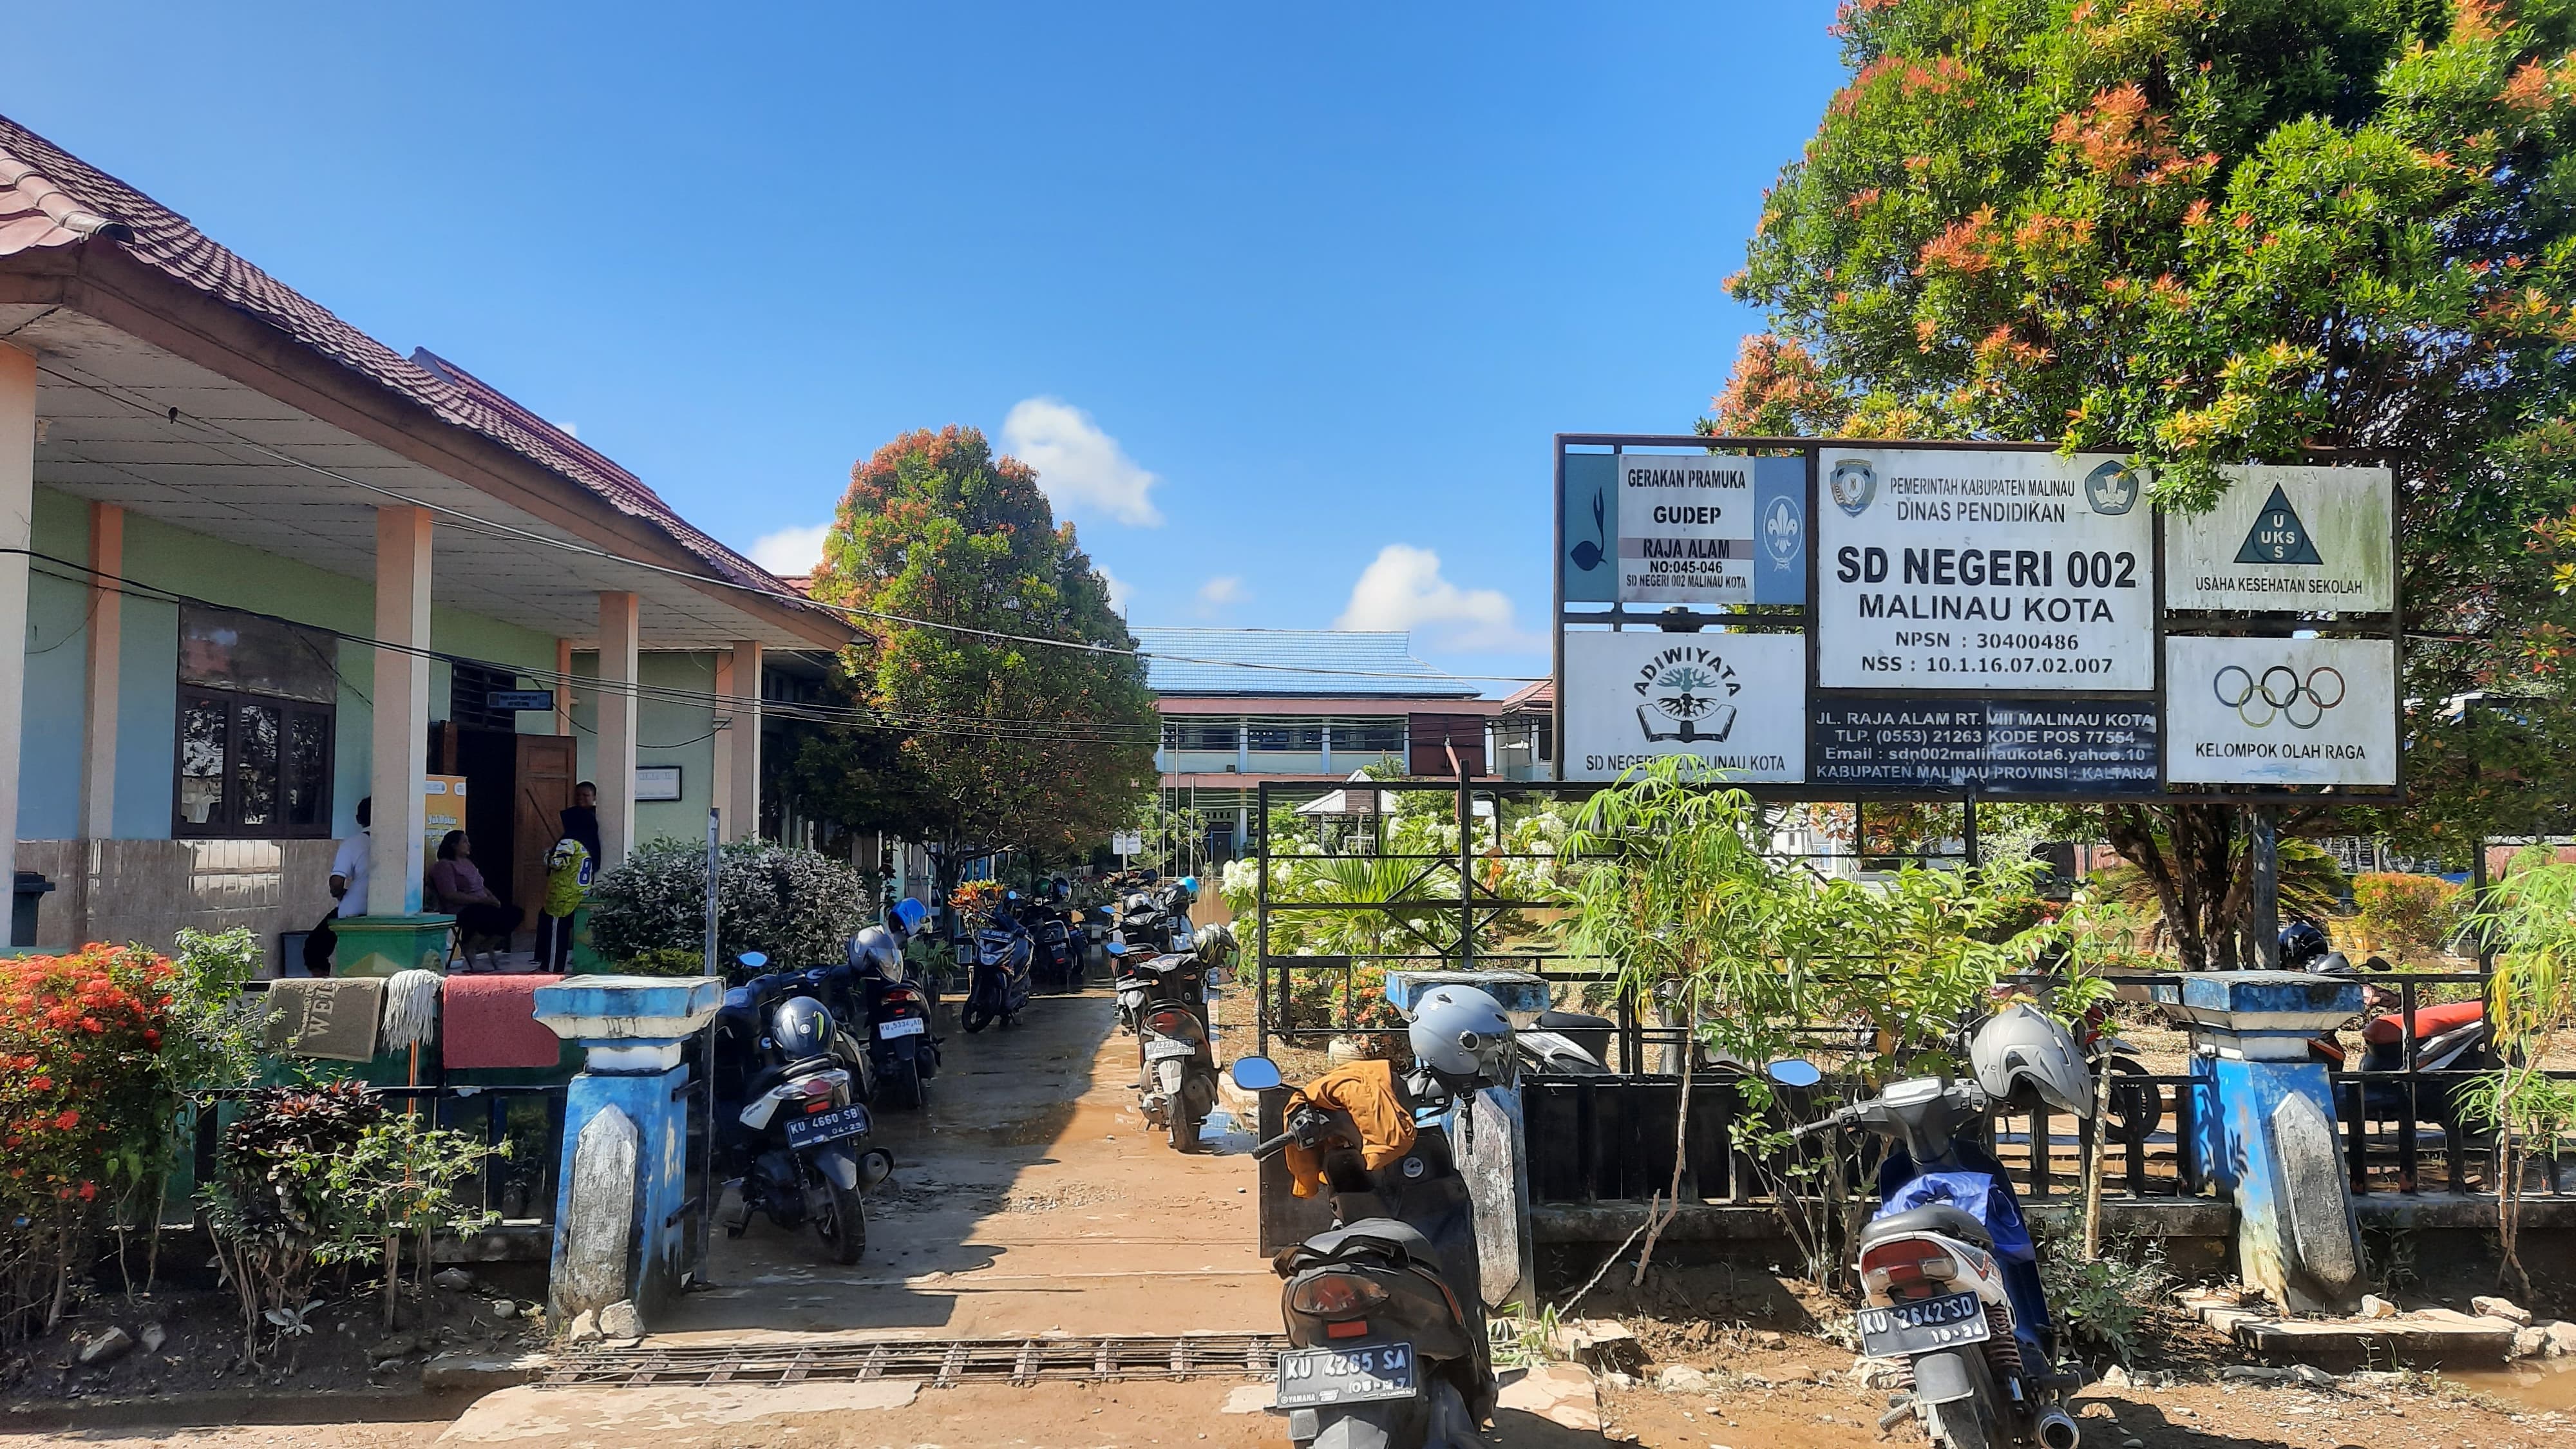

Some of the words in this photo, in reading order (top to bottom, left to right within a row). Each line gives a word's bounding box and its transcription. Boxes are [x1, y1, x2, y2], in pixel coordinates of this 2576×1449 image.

[1628, 469, 1685, 488] GERAKAN
[1689, 469, 1746, 489] PRAMUKA
[1891, 477, 1958, 496] PEMERINTAH
[1961, 478, 2025, 497] KABUPATEN
[2029, 478, 2075, 497] MALINAU
[1653, 506, 1721, 524] GUDEP
[1897, 502, 1951, 522] DINAS
[1957, 502, 2065, 523] PENDIDIKAN
[2260, 531, 2295, 544] UKS
[1643, 538, 1682, 558] RAJA
[1688, 540, 1730, 558] ALAM
[1649, 560, 1723, 574] NO:045-046
[1837, 546, 1889, 583] SD
[1904, 548, 2052, 587] NEGERI
[2067, 551, 2137, 589] 002
[1626, 575, 1637, 587] SD
[1640, 575, 1669, 587] NEGERI
[1671, 575, 1685, 587] 002
[1687, 575, 1723, 588] MALINAU
[1726, 576, 1747, 589] KOTA
[2196, 577, 2235, 592] USAHA
[2239, 578, 2305, 592] KESEHATAN
[2309, 580, 2363, 594] SEKOLAH
[1859, 594, 2011, 621] MALINAU
[2025, 598, 2114, 623] KOTA
[1895, 631, 1950, 647] NPSN
[1976, 634, 2079, 650] 30400486
[1634, 647, 1742, 697] ADIWIYATA
[1862, 656, 1902, 672] NSS
[1927, 657, 2113, 674] 10.1.16.07.02.007
[1816, 712, 1841, 724] JL.
[1847, 712, 1895, 725] RAJA
[1899, 712, 1950, 725] ALAM
[1956, 712, 1982, 725] RT.
[2019, 713, 2099, 726] MALINAU
[2105, 714, 2155, 726] KOTA
[1835, 730, 1870, 743] TLP.
[1877, 730, 1927, 745] (0553)
[1933, 730, 1982, 743] 21263
[1988, 730, 2038, 743] KODE
[2043, 730, 2080, 743] POS
[2086, 731, 2136, 744] 77554
[1825, 746, 1872, 760] Email
[2196, 743, 2278, 758] KELOMPOK
[2282, 744, 2320, 759] OLAH
[2325, 744, 2365, 759] RAGA
[1586, 755, 1604, 770] SD
[1750, 755, 1786, 771] KOTA
[1817, 765, 1912, 778] KABUPATEN
[1917, 766, 1989, 779] MALINAU
[1994, 766, 2069, 779] PROVINSI
[2082, 766, 2155, 779] KALTARA
[790, 1121, 806, 1134] KU
[812, 1113, 839, 1128] 4660
[844, 1108, 858, 1120] SB
[1861, 1311, 1888, 1334] KU
[1949, 1296, 1975, 1318] SD
[1287, 1358, 1312, 1379] KU
[1324, 1352, 1374, 1376] 4265
[1383, 1349, 1406, 1370] SA
[1289, 1394, 1316, 1403] YAMAHA
